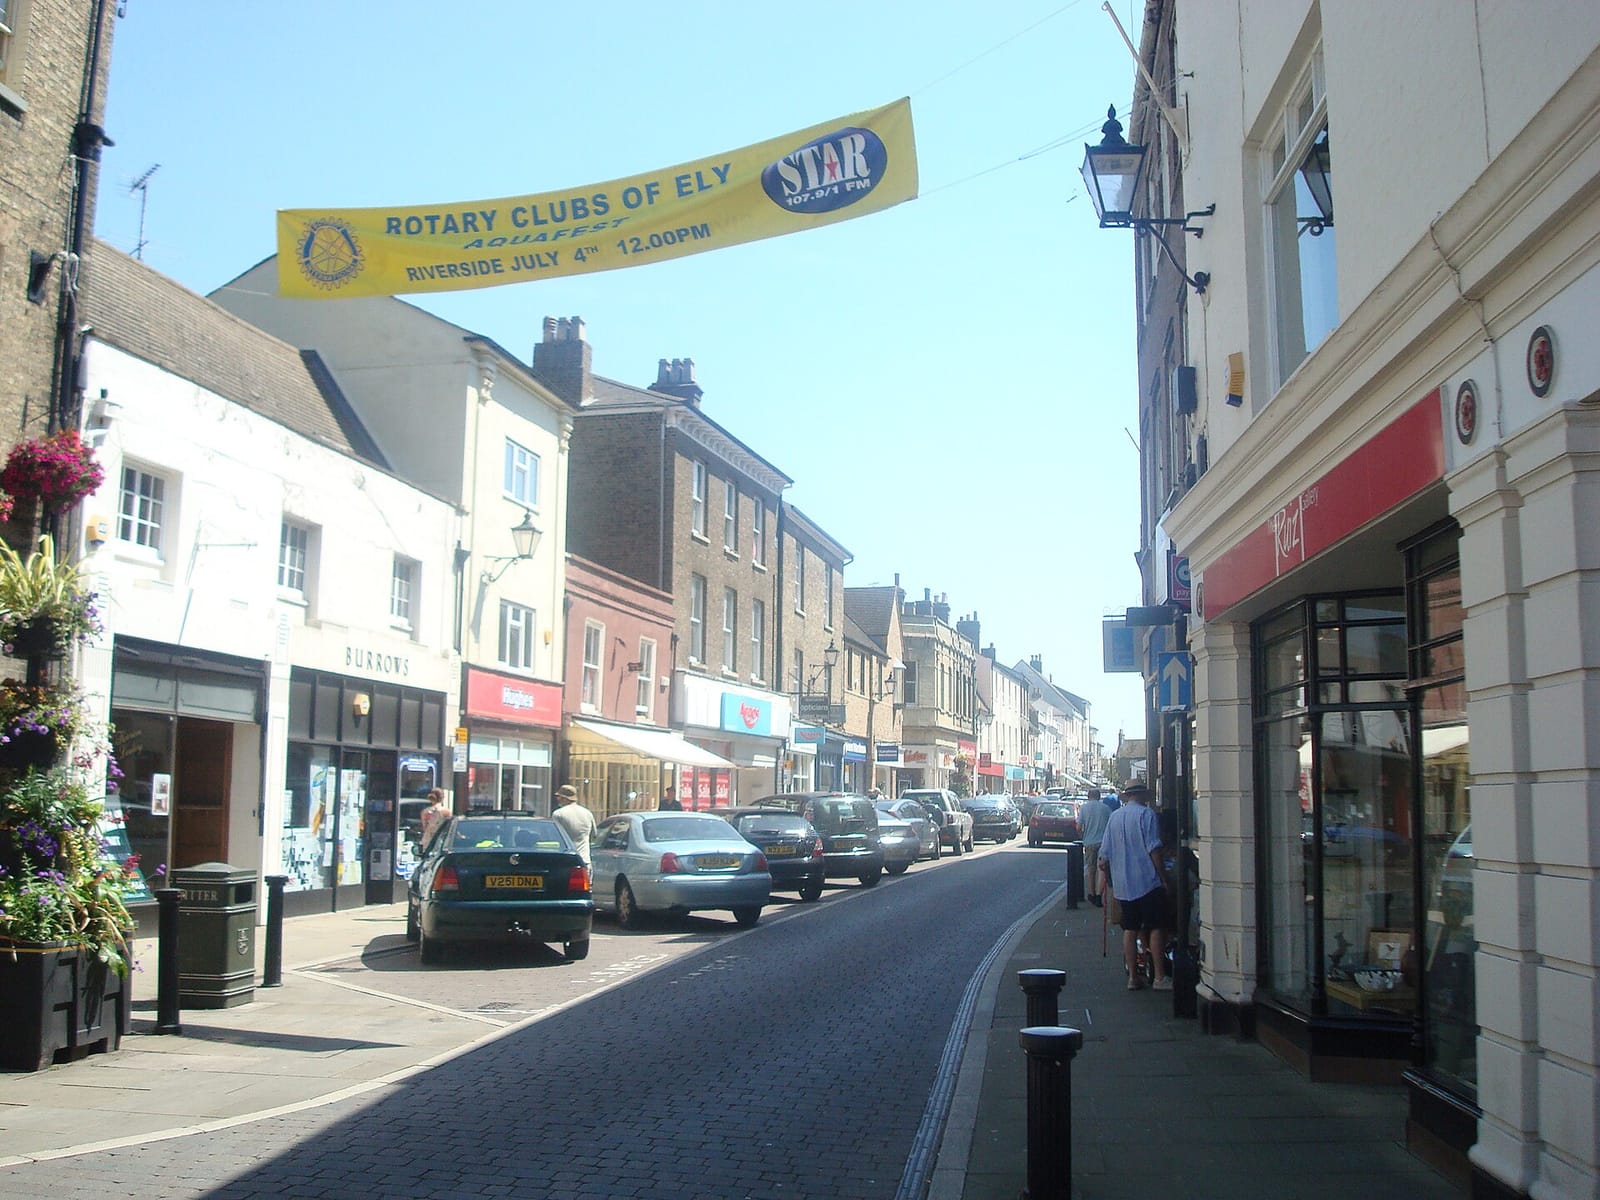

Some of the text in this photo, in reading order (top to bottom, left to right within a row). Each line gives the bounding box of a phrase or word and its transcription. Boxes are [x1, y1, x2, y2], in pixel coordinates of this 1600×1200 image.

[777, 133, 871, 197] STAR
[385, 162, 732, 235] ROTARY CLUBS OF ELY
[845, 178, 872, 191] FM
[463, 216, 631, 249] AQUAFEST
[406, 258, 505, 281] RIVERSIDE
[511, 251, 559, 272] JULY
[617, 223, 712, 255] 12.00PM
[345, 646, 409, 677] BURROWS
[184, 890, 218, 901] ITTER
[490, 876, 539, 887] V251 DNA
